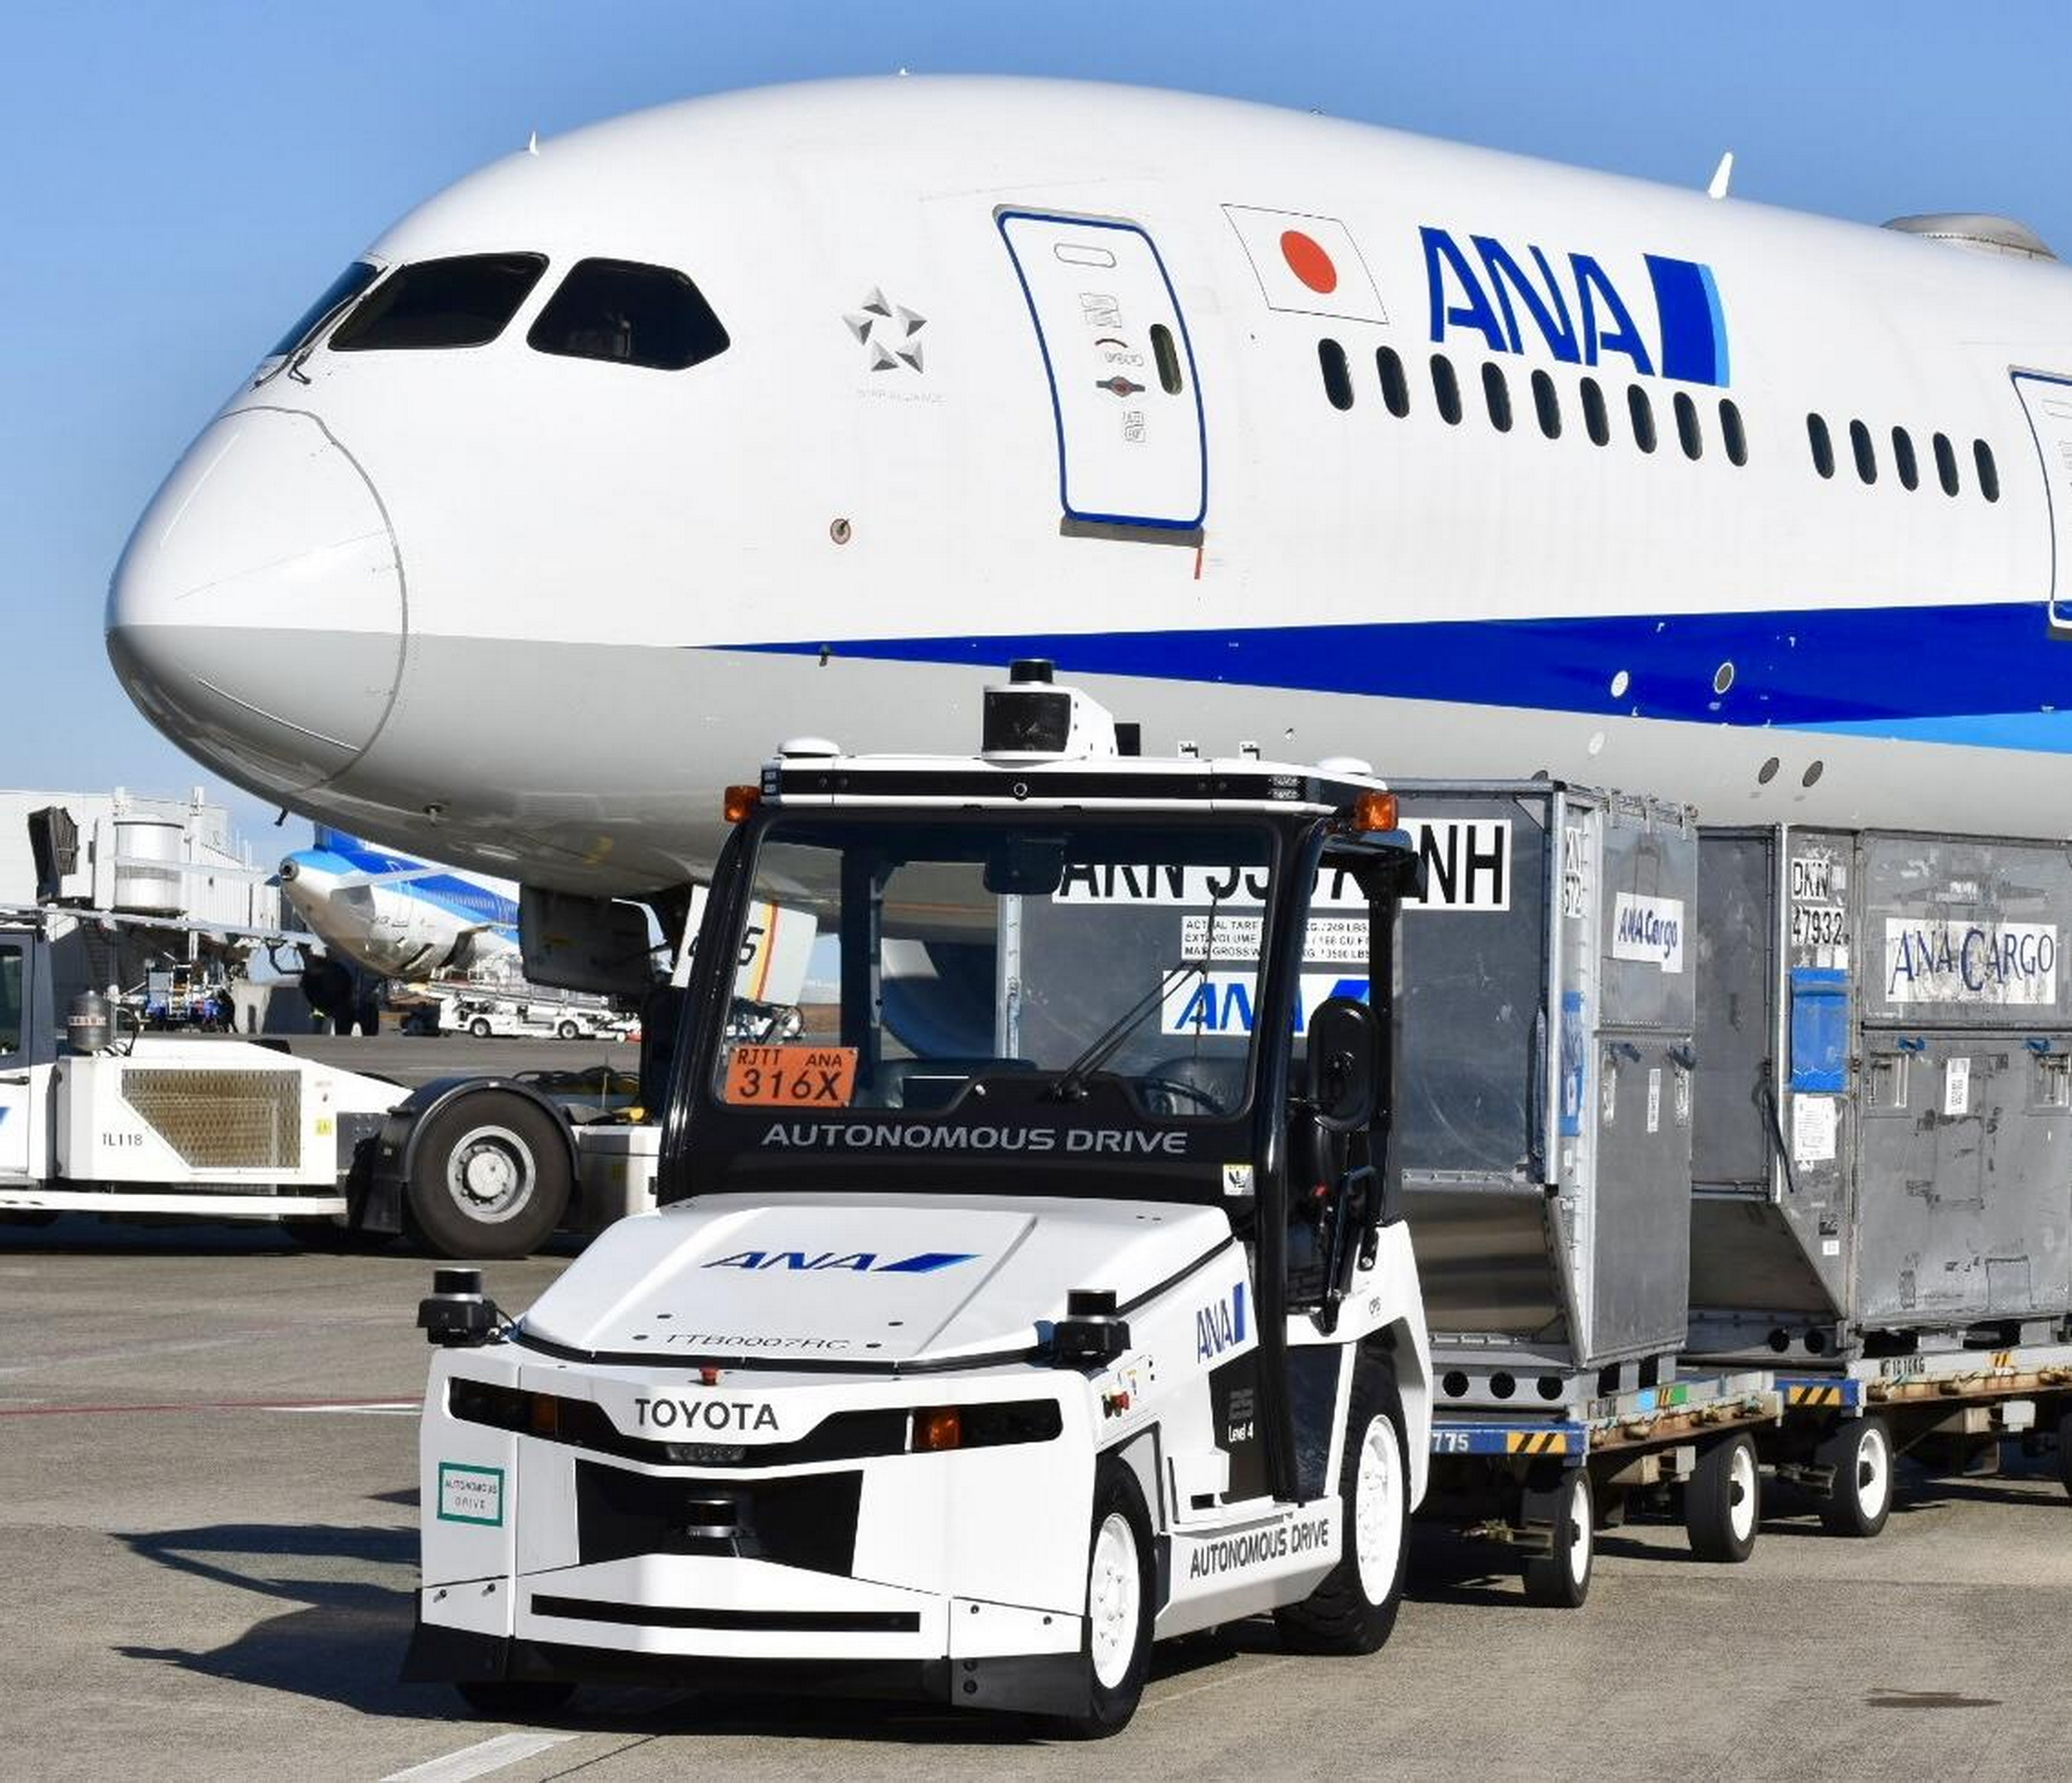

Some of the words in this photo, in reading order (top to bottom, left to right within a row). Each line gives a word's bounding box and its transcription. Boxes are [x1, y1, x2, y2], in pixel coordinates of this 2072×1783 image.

[1418, 225, 1656, 376] ANA
[1618, 907, 1644, 944] ANA
[1645, 909, 1677, 959] Cargo
[1793, 908, 1842, 945] 47932
[1888, 929, 1954, 994] ANA
[1960, 927, 2054, 991] CARGO
[805, 1054, 842, 1067] ANA
[739, 1068, 842, 1102] 316X
[761, 1123, 1056, 1151] AUTONOMOUS
[1065, 1129, 1188, 1154] DRIVE
[700, 1252, 878, 1271] ANA
[1196, 1298, 1233, 1364] ANA
[635, 1398, 779, 1431] TOYOTA
[1190, 1527, 1288, 1580] AUTONOMOUS
[1291, 1518, 1329, 1554] DRIVE
